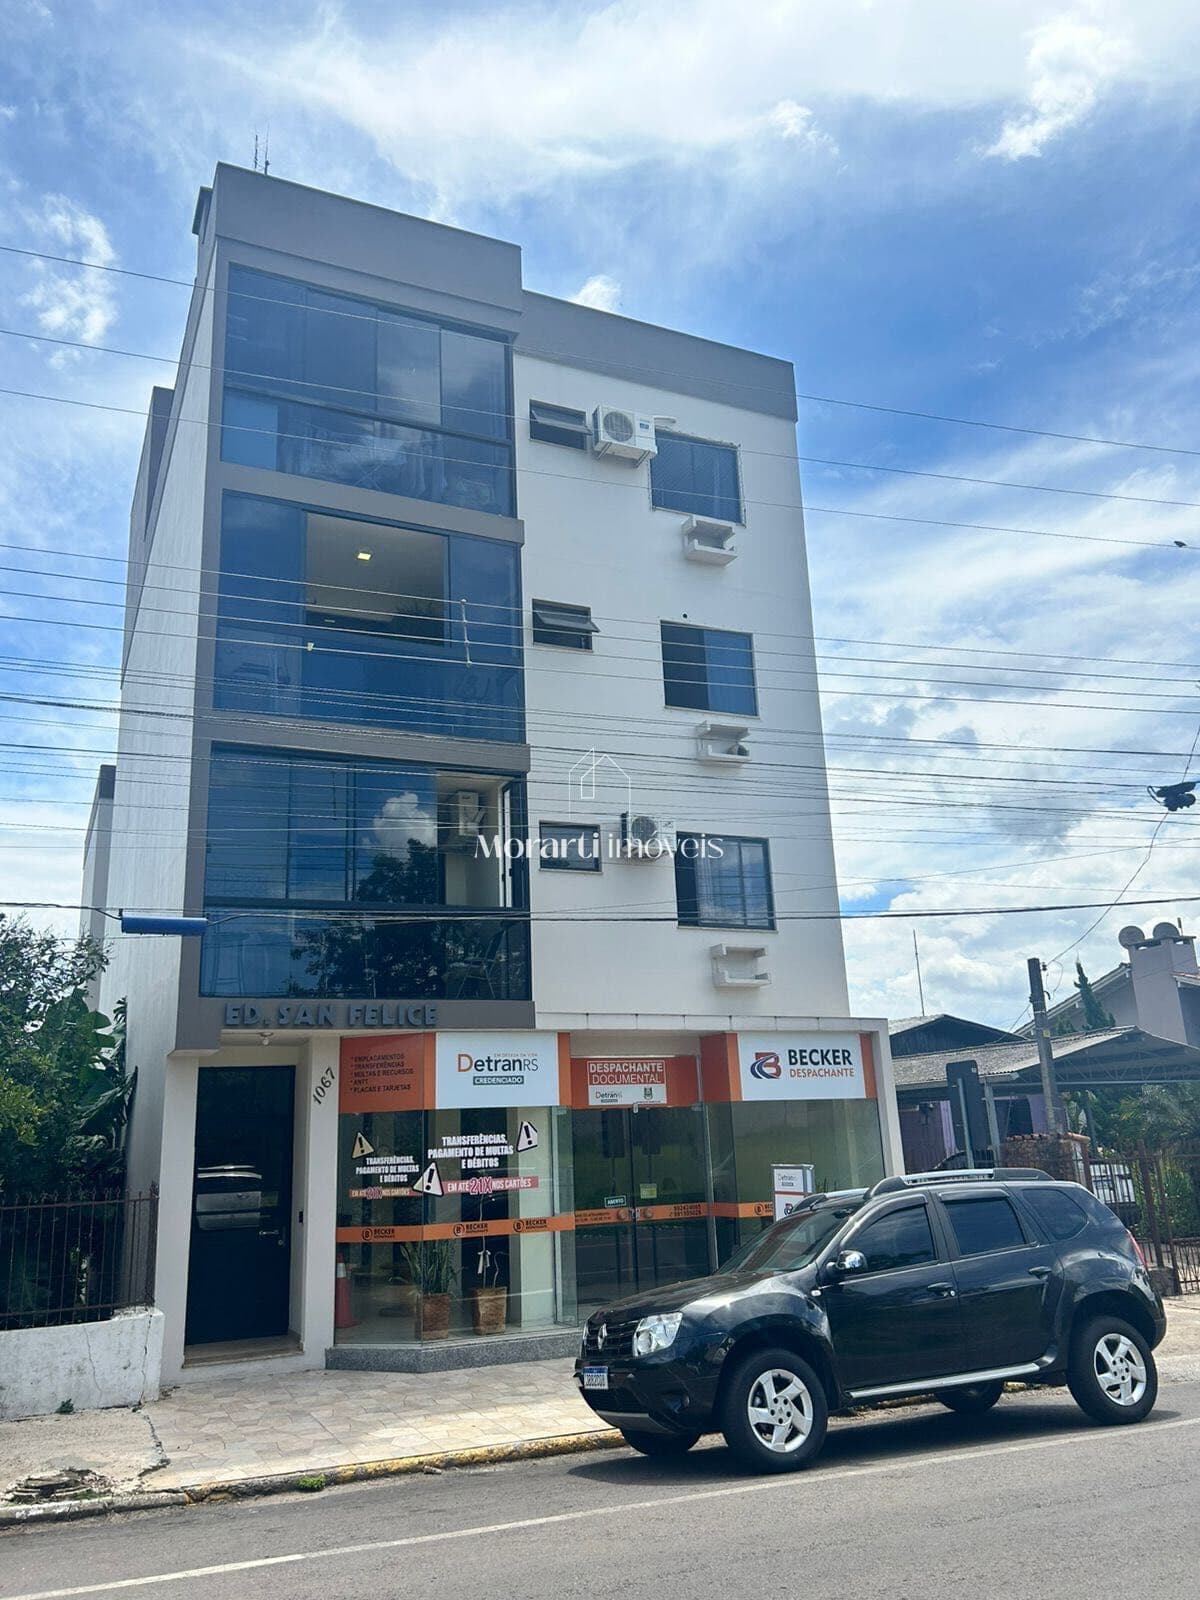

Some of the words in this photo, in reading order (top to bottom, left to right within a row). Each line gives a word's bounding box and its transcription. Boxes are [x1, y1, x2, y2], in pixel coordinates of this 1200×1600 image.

[225, 1003, 269, 1026] ED.
[278, 1003, 336, 1026] SAN
[349, 1003, 439, 1026] FELICE
[354, 1054, 404, 1062] EMPLACAMENTOS
[457, 1053, 539, 1072] DetranRS
[787, 1048, 853, 1066] BECKER
[589, 1062, 663, 1073] DESPACHANTE
[789, 1068, 855, 1078] DESPACHANTE
[475, 1076, 522, 1084] CREDENCIADO
[592, 1073, 661, 1085] DOCUMENTAL
[313, 1067, 336, 1105] 1067
[427, 1147, 473, 1159] PAGAMENTO
[474, 1146, 485, 1157] DE
[485, 1145, 514, 1156] MULTAS
[355, 1166, 389, 1174] PAGAMENTO
[390, 1165, 397, 1173] DE
[398, 1164, 419, 1173] MULTAS
[461, 1159, 466, 1169] E
[467, 1157, 499, 1168] DÉBITOS
[384, 1174, 408, 1182] DÉBITOS
[447, 1183, 456, 1192] EM
[457, 1181, 469, 1191] ATÉ
[469, 1177, 493, 1195] 21X
[492, 1180, 504, 1190] NOS
[505, 1177, 532, 1189] CARTÕES
